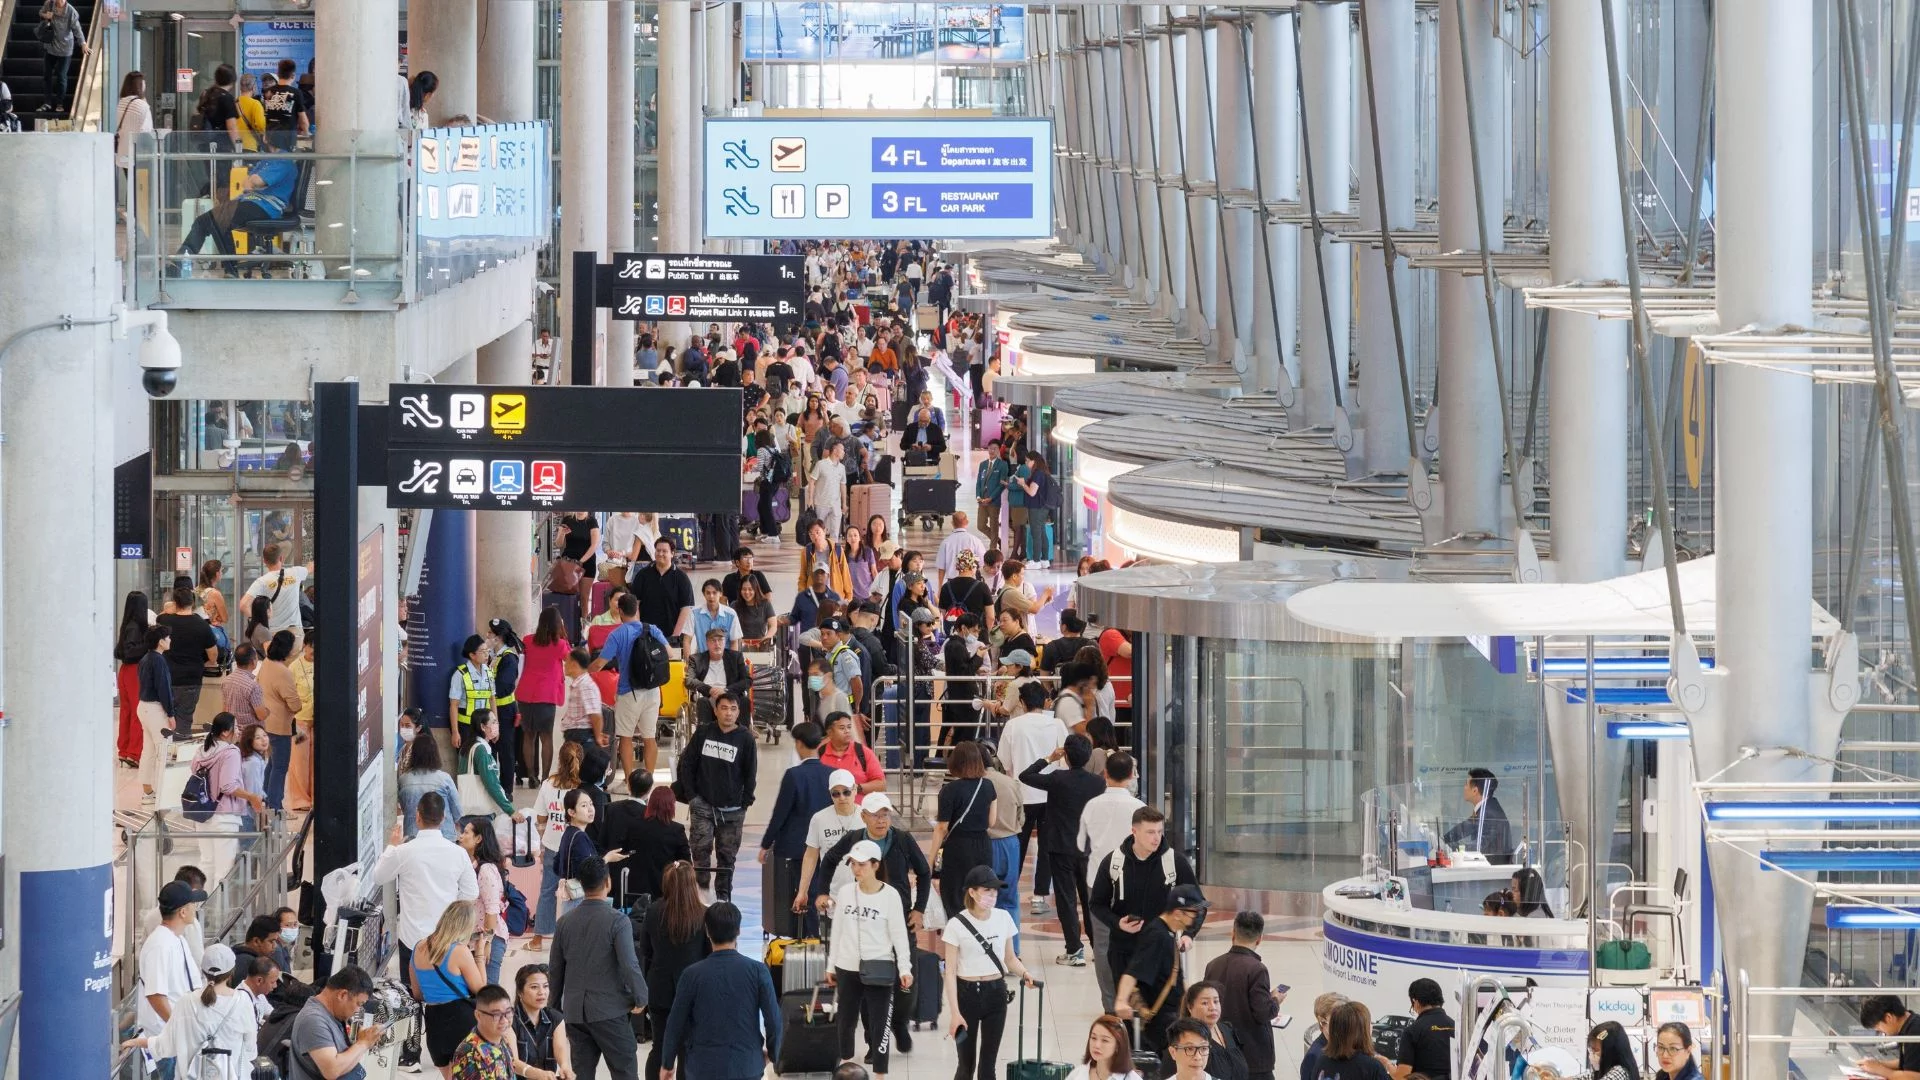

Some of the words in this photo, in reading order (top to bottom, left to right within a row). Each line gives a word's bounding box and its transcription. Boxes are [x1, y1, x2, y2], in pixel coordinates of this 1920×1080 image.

[880, 144, 899, 166] 4
[903, 149, 928, 166] FL
[940, 157, 986, 167] Departures
[882, 190, 899, 213] 3
[904, 196, 928, 213] FL
[940, 192, 1000, 201] RESTAURANT
[940, 204, 960, 213] CAR
[961, 204, 986, 213] PARK
[667, 272, 689, 280] Public
[690, 272, 705, 280] Taxi
[689, 308, 713, 318] Airport
[713, 308, 728, 317] Rail
[728, 309, 743, 317] Link
[121, 547, 142, 556] SD2
[844, 904, 880, 921] GANT
[1347, 970, 1377, 988] Limousine
[1598, 1000, 1635, 1014] kkday
[1553, 1025, 1576, 1034] Dieter
[878, 1025, 891, 1054] CALVIN
[1544, 1035, 1574, 1044] Schluck
